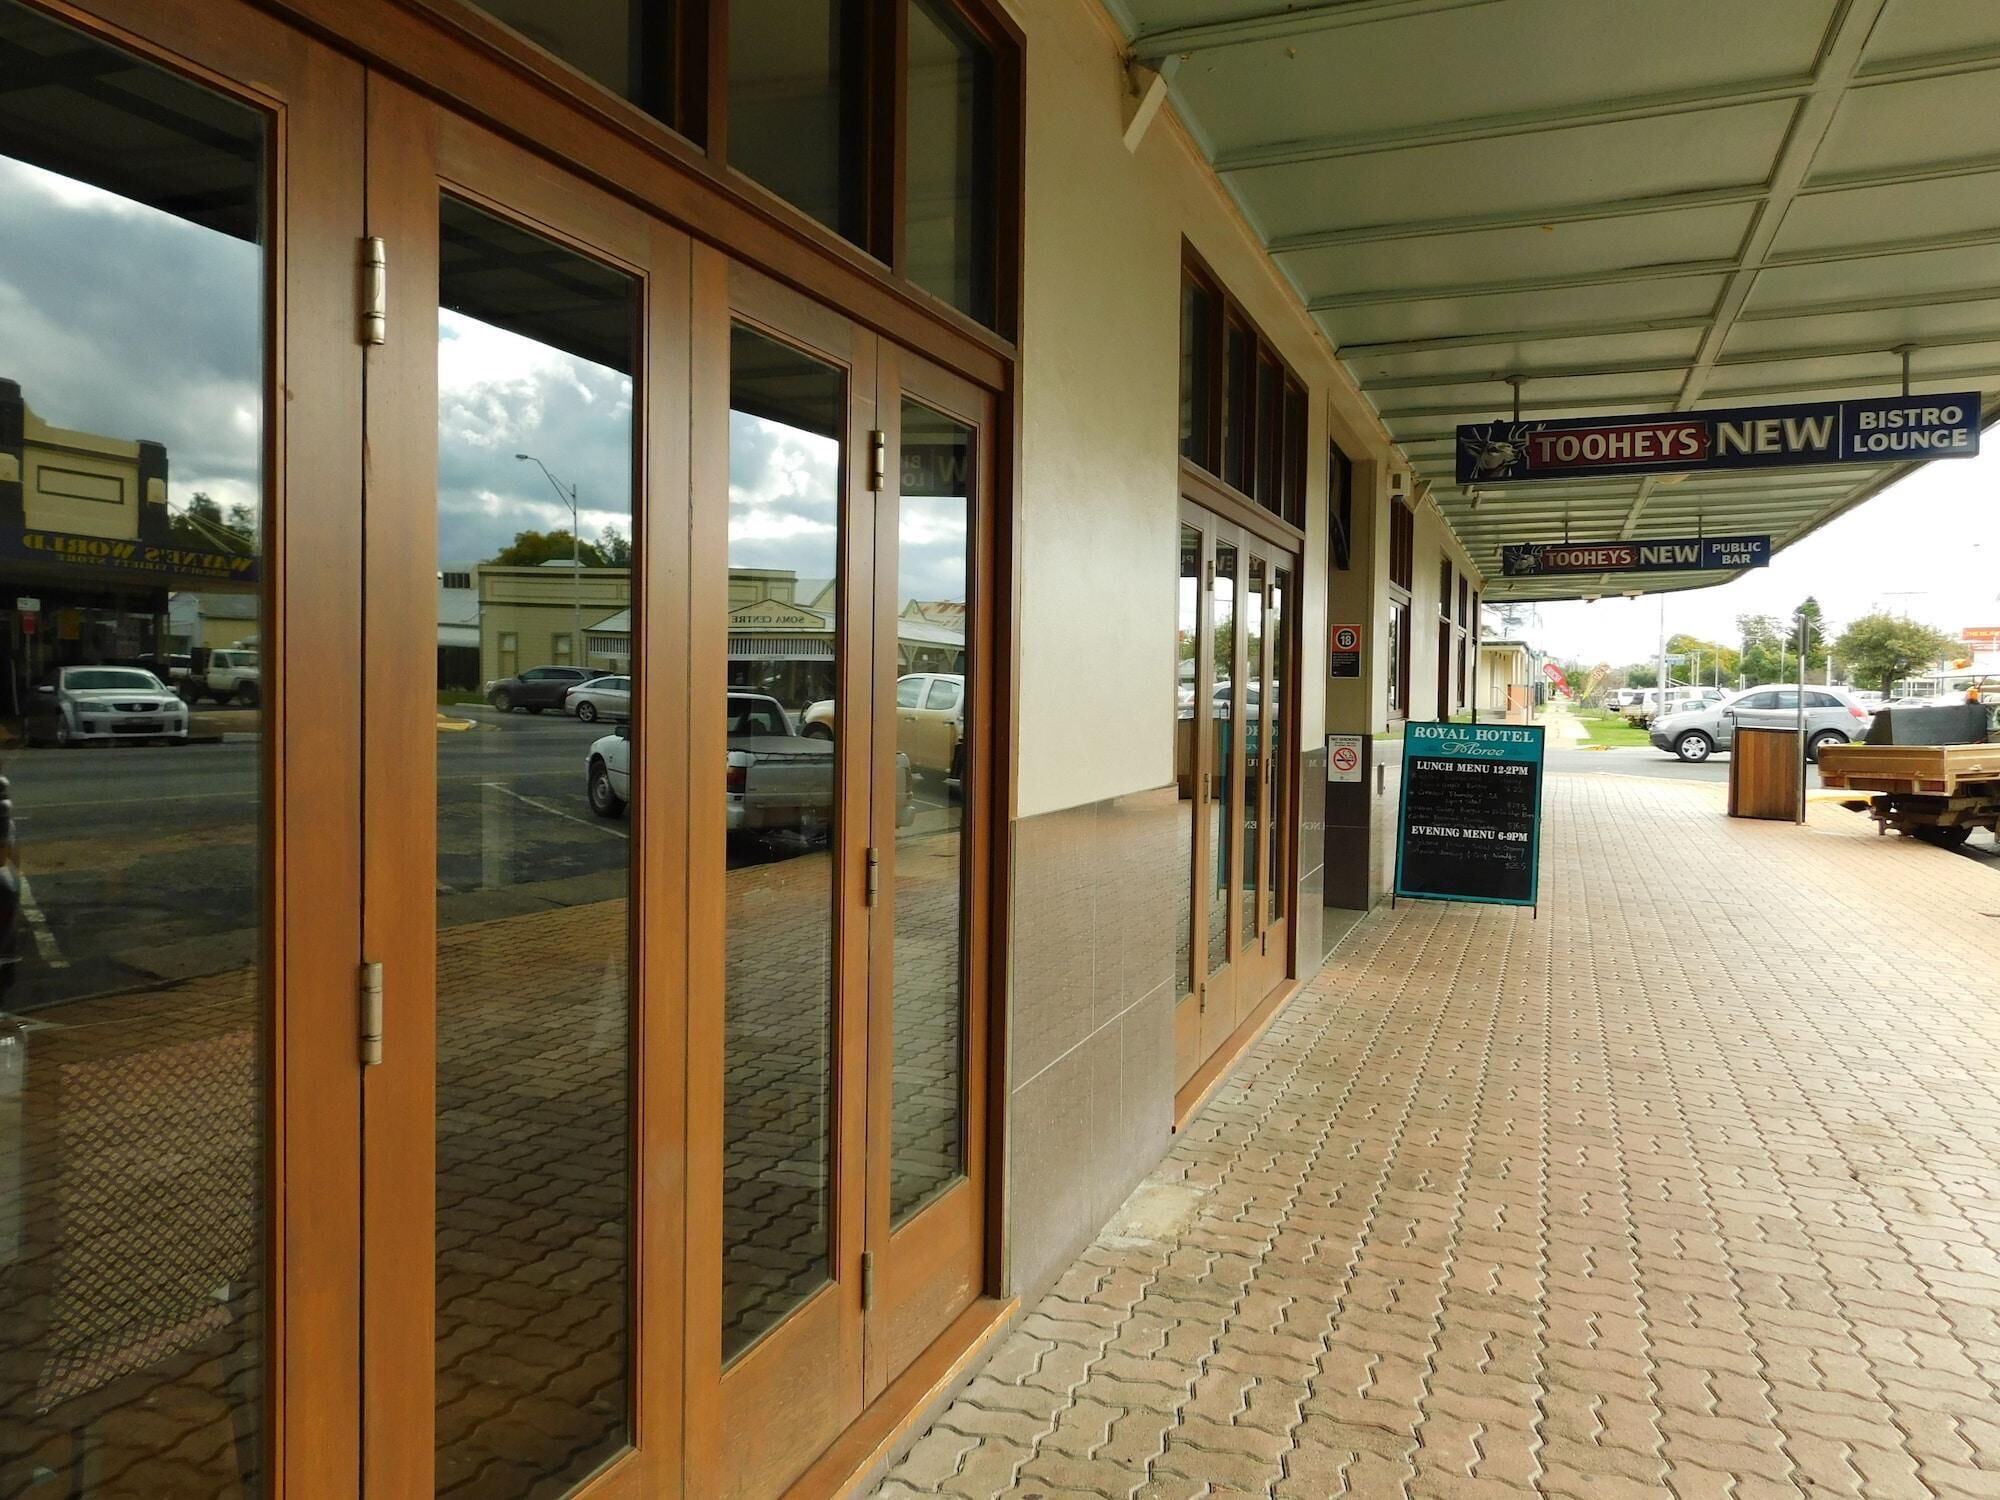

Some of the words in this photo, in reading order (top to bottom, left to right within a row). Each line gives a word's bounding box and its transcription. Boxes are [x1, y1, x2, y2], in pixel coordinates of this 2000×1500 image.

[1859, 405, 1963, 430] BISTRO
[1536, 428, 1699, 463] TOOHEYS
[1716, 415, 1835, 457] NEW
[1853, 428, 1968, 453] LOUNGE
[1549, 549, 1632, 567] TOOHEYS
[1639, 544, 1700, 565] NEW
[1712, 541, 1762, 554] PUBLIC
[1721, 553, 1751, 565] BAR
[1340, 635, 1352, 645] 18
[1414, 726, 1469, 740] ROYAL
[1475, 729, 1534, 743] HOTEL
[1441, 741, 1505, 756] Moree
[1416, 760, 1453, 772] LUNCH
[1457, 763, 1490, 774] MENU
[1493, 765, 1528, 776] 12-2PM
[1411, 825, 1460, 838] EVENING
[1462, 829, 1496, 840] MENU
[1498, 831, 1528, 842] 6-9PM
